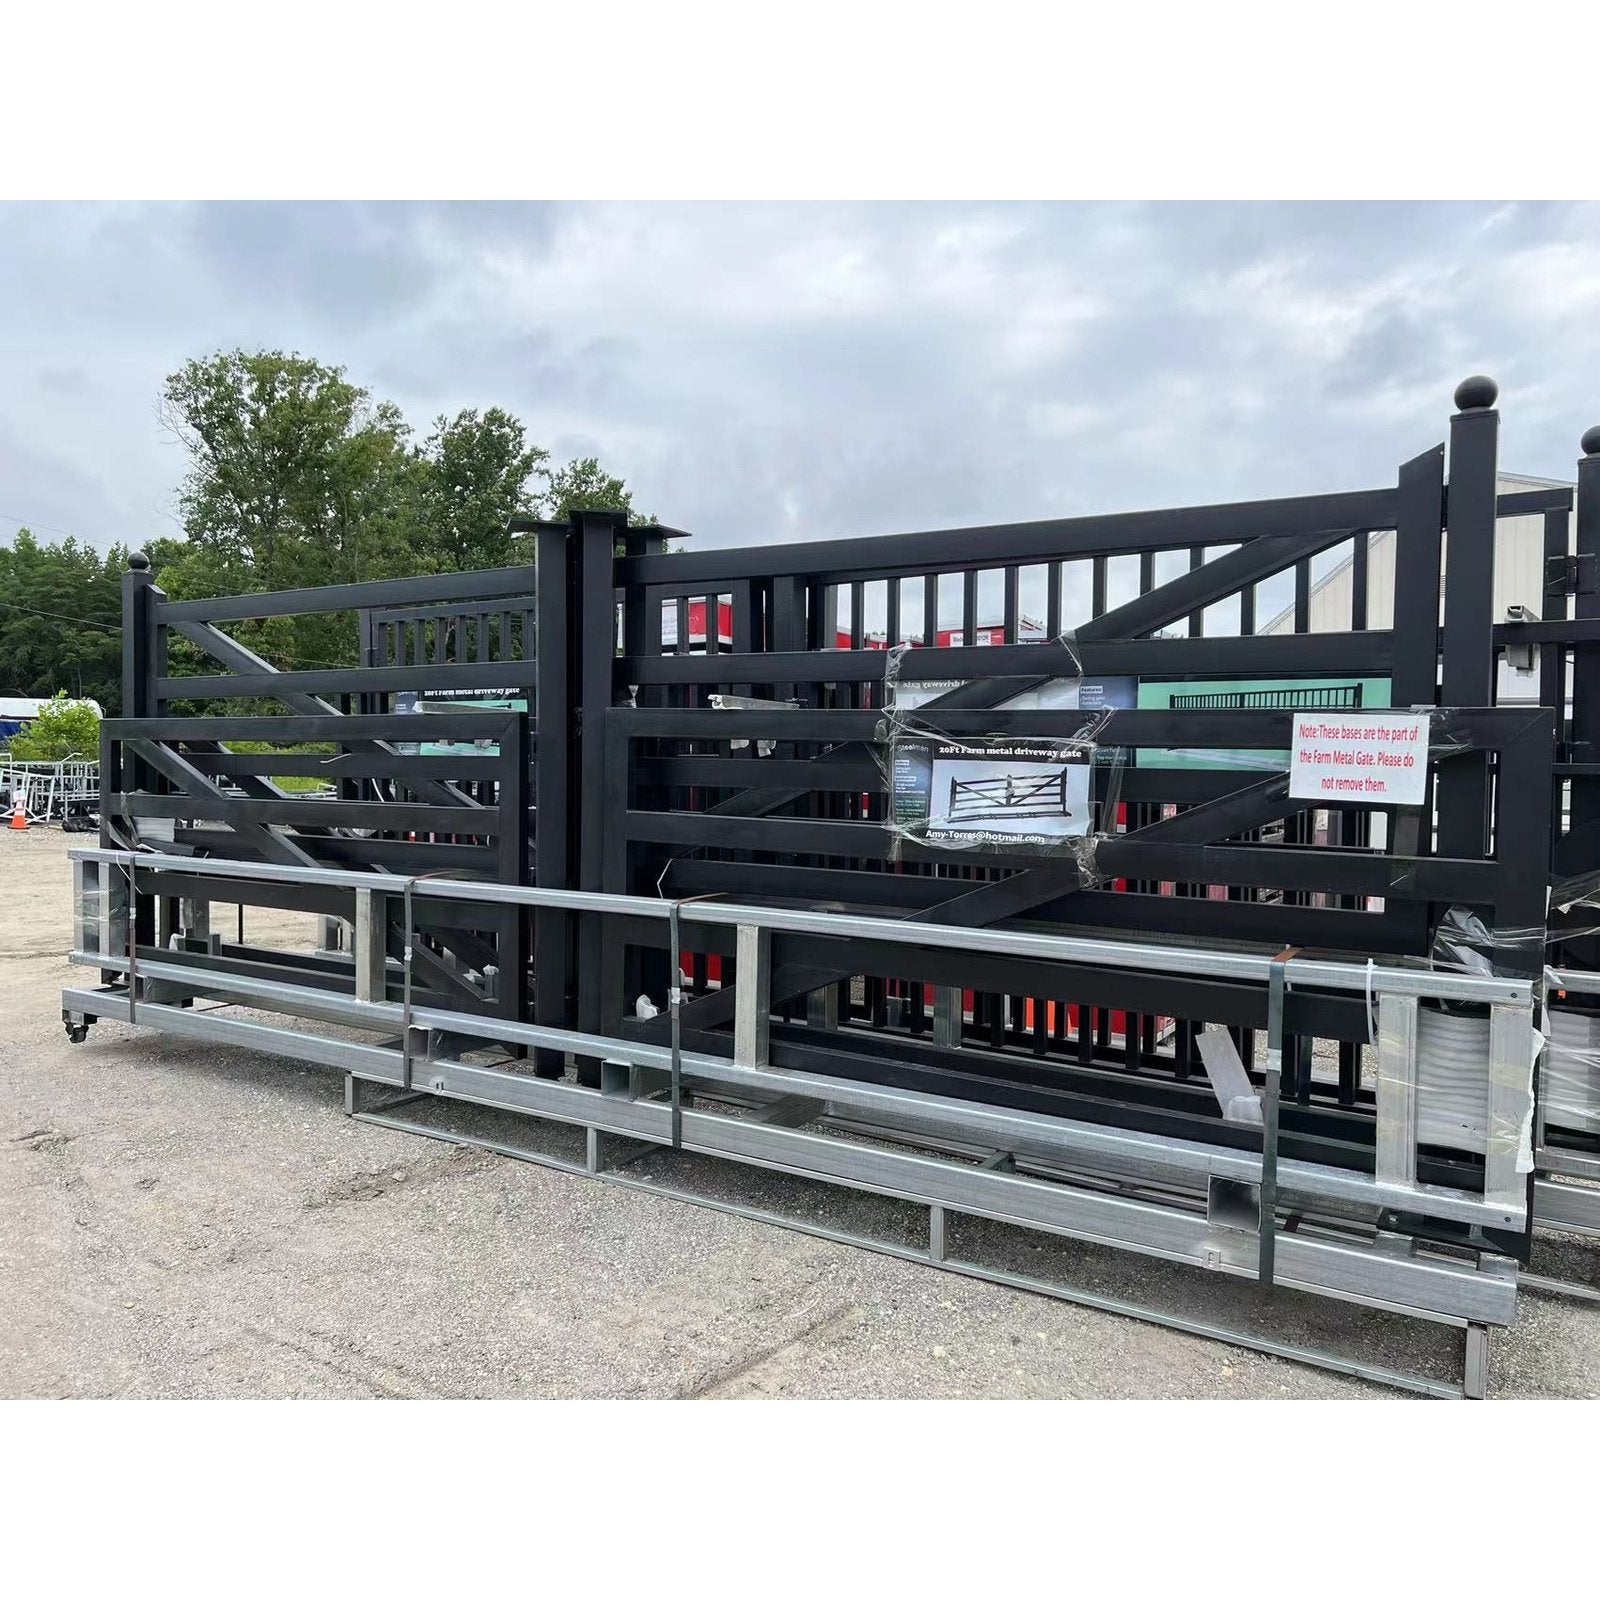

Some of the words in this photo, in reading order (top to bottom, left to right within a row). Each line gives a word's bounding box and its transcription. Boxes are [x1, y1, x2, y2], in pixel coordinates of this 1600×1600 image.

[1342, 724, 1362, 740] bases
[1364, 728, 1376, 740] are
[1377, 726, 1390, 740] the
[1391, 727, 1408, 744] part
[1408, 726, 1419, 741] of
[939, 746, 960, 754] 20Ft
[961, 746, 986, 755] Farm
[986, 747, 1013, 755] metal
[1014, 747, 1059, 758] driveway
[1059, 749, 1083, 759] gate
[1300, 750, 1312, 763] the
[1313, 750, 1331, 764] Farm
[1333, 750, 1355, 765] Metal
[1355, 751, 1376, 766] Gate.
[1377, 752, 1401, 767] Please
[1403, 753, 1414, 767] do
[1321, 776, 1334, 789] not
[1335, 780, 1363, 791] remove
[1365, 776, 1387, 792] them.
[926, 830, 1045, 843] Amy-Torres@hotmail.com
